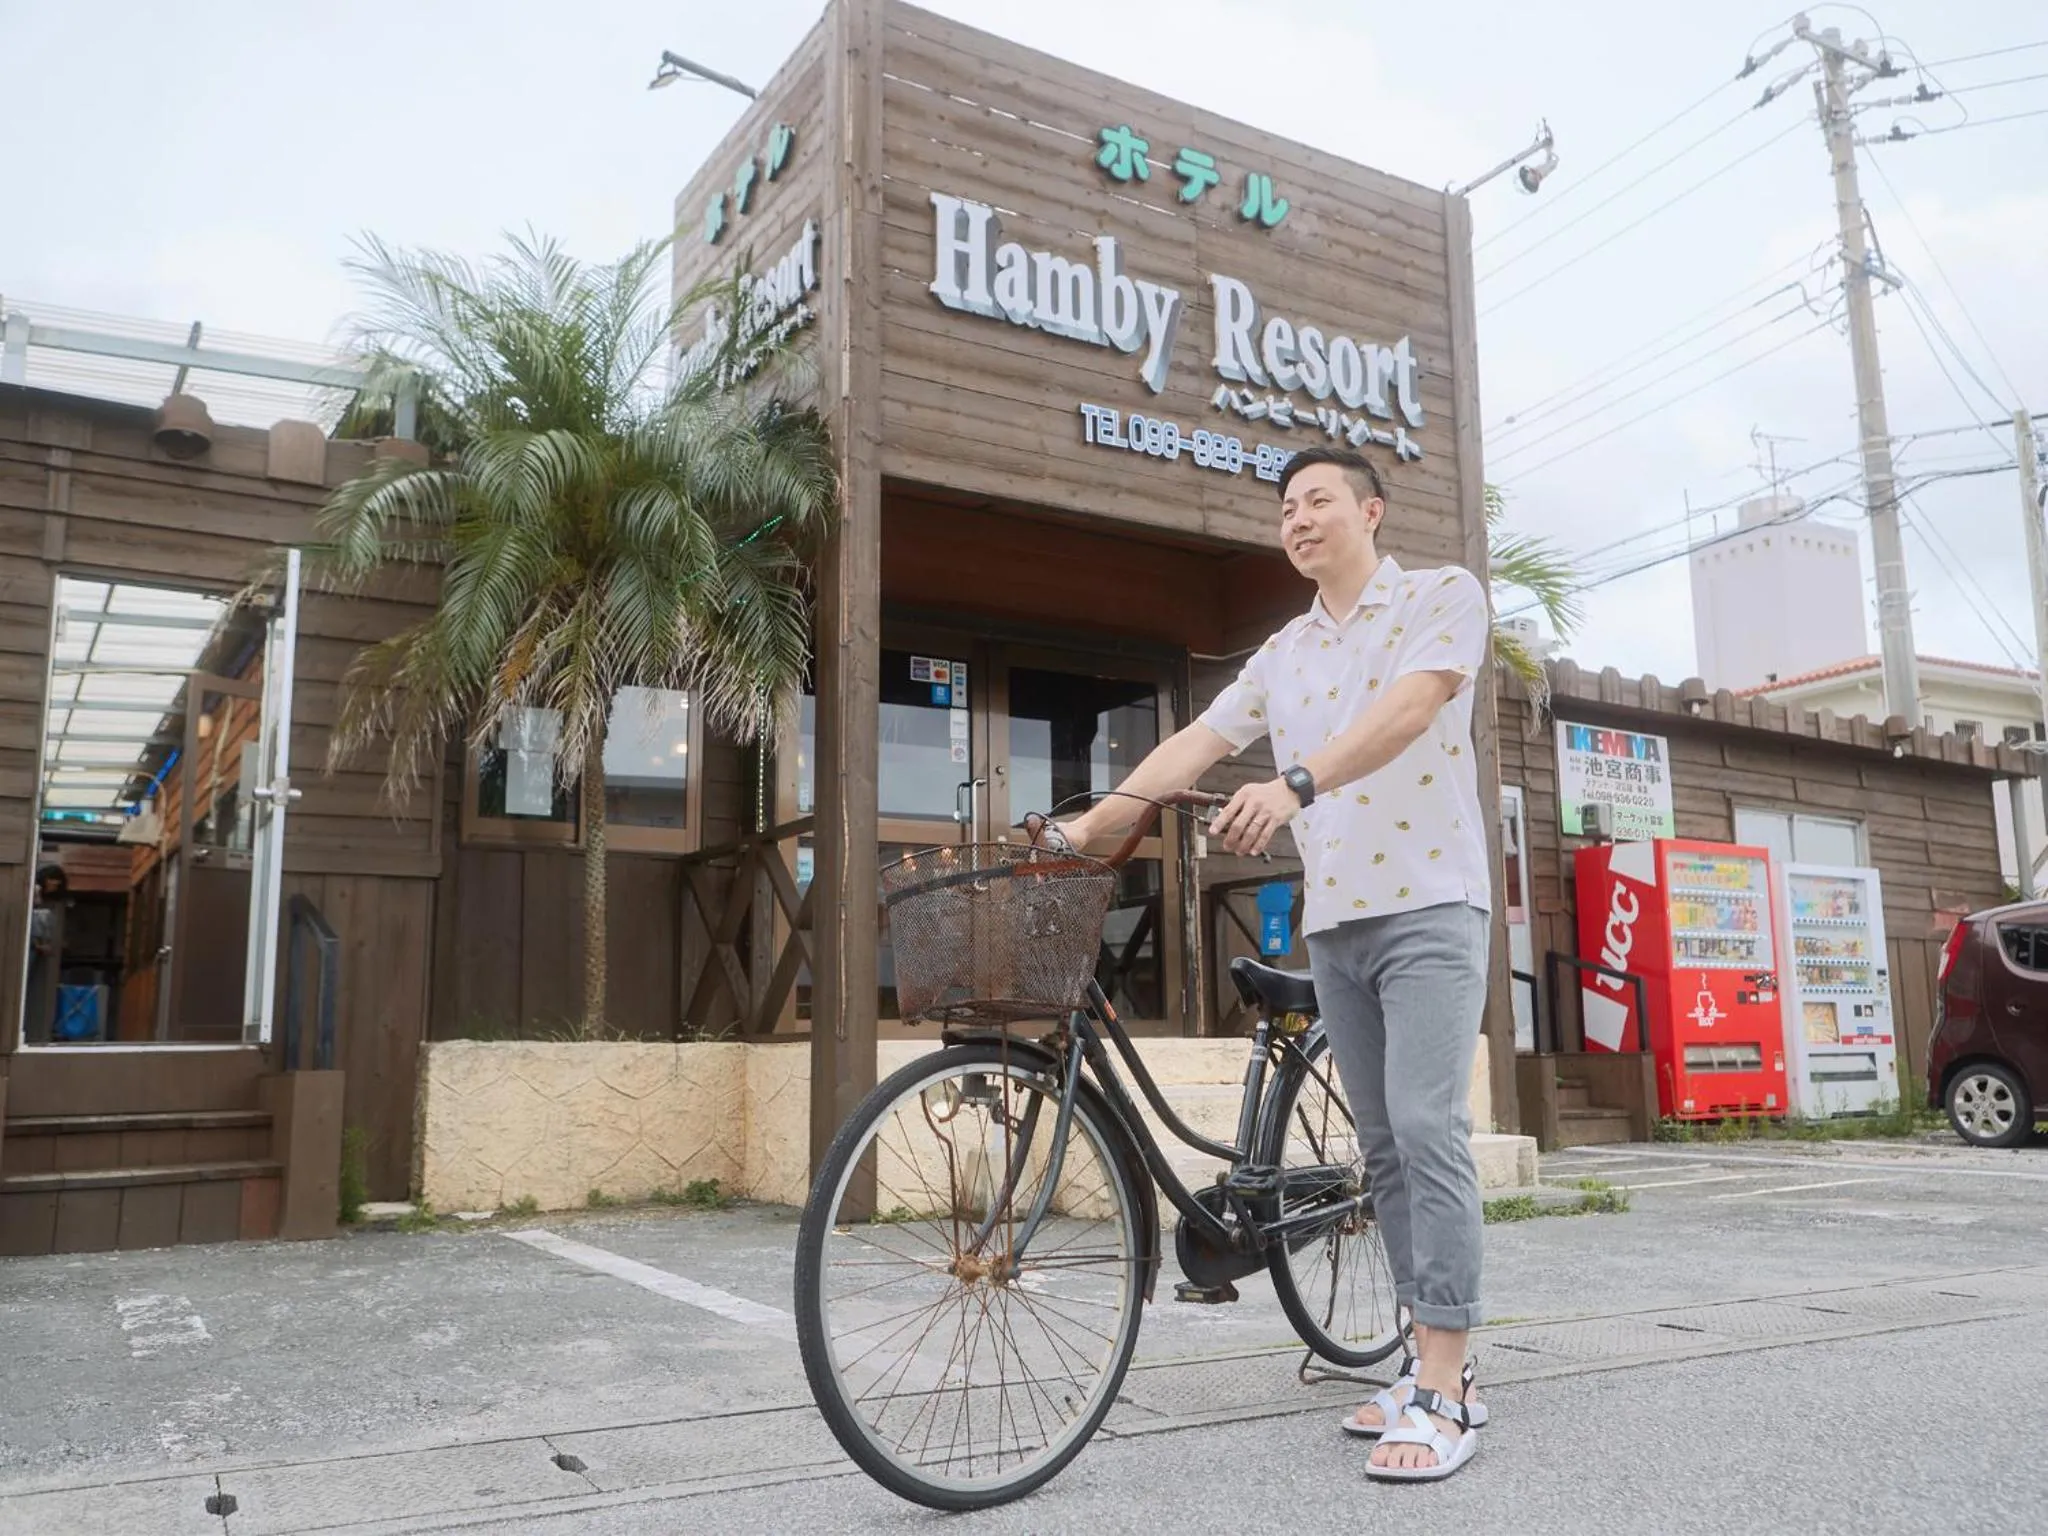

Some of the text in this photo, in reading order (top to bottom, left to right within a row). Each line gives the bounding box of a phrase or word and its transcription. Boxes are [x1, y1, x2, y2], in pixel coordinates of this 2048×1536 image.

[1095, 125, 1290, 228] ホテル
[930, 191, 1181, 394] Hamby
[1207, 272, 1425, 428] Resort
[1584, 756, 1662, 784] 池宮商事
